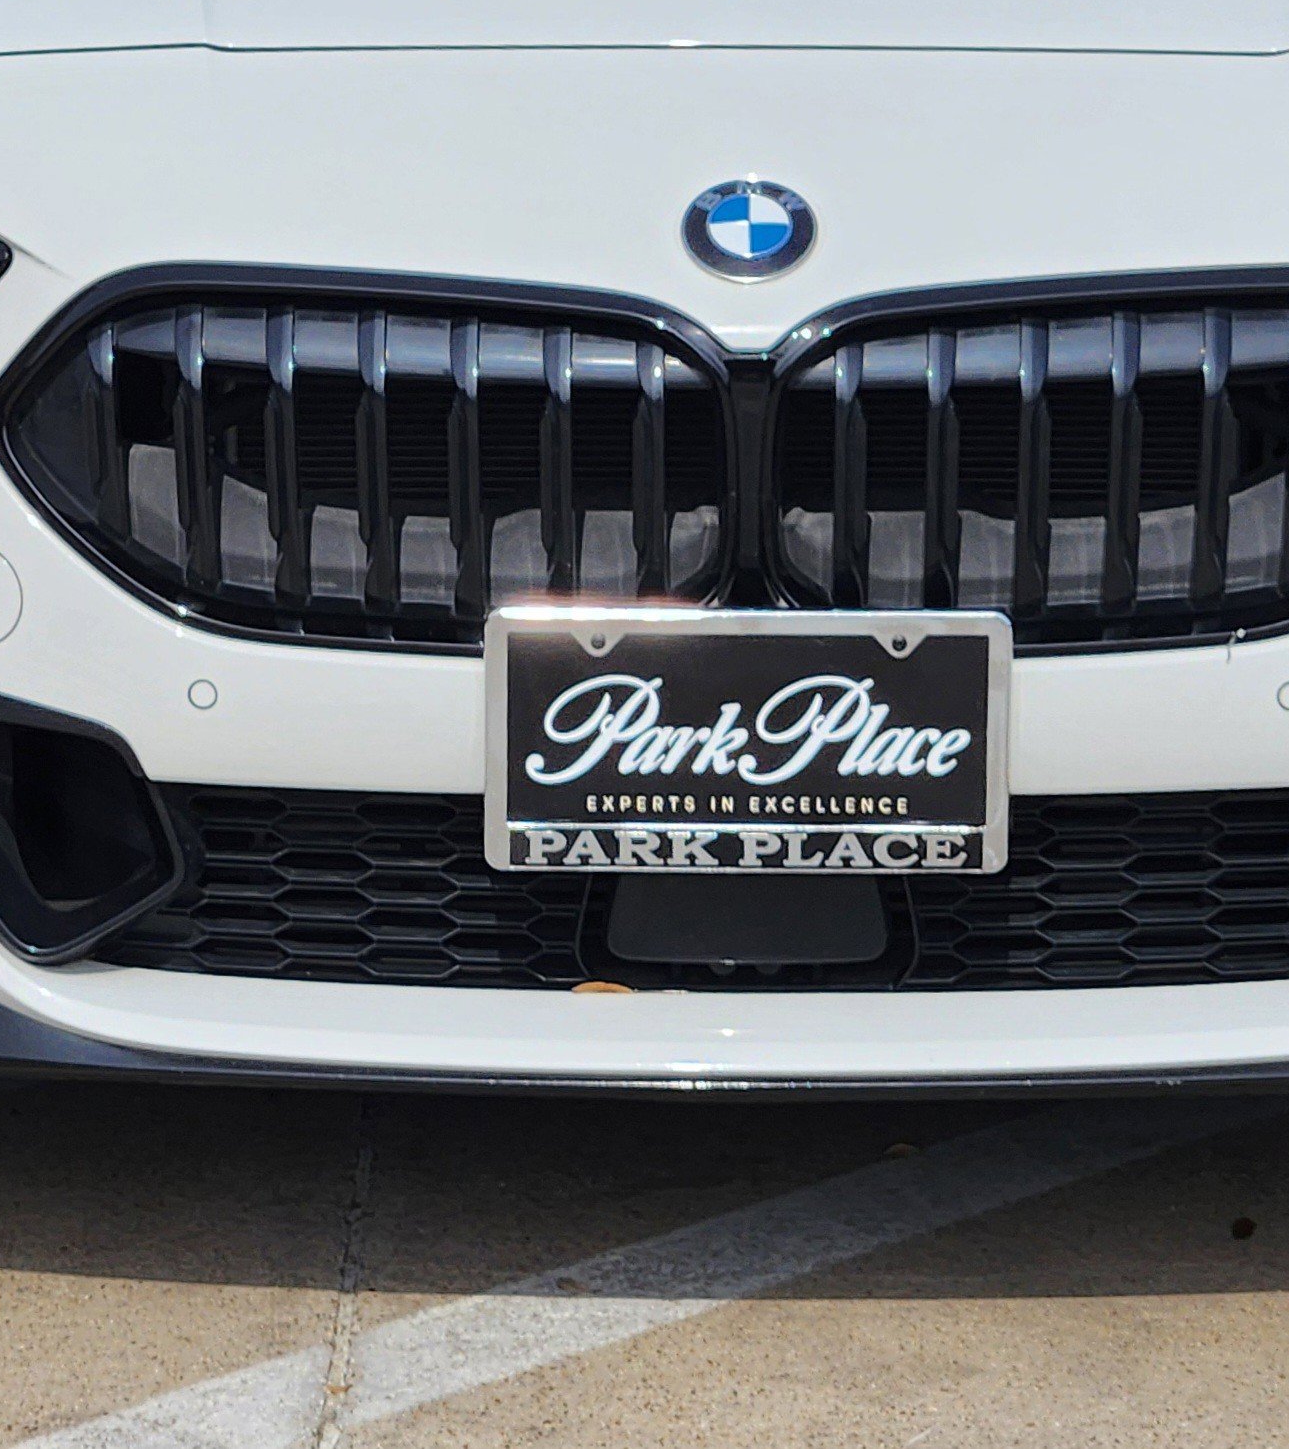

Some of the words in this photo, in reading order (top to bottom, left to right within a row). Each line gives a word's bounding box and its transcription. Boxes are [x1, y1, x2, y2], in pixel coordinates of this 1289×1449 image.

[525, 673, 749, 786] Park
[737, 673, 971, 787] Place
[585, 794, 696, 814] EXPERTS
[709, 795, 734, 814] IN
[748, 795, 909, 816] EXCELLENCE
[524, 829, 720, 866] PARK
[738, 830, 969, 869] PLACE
